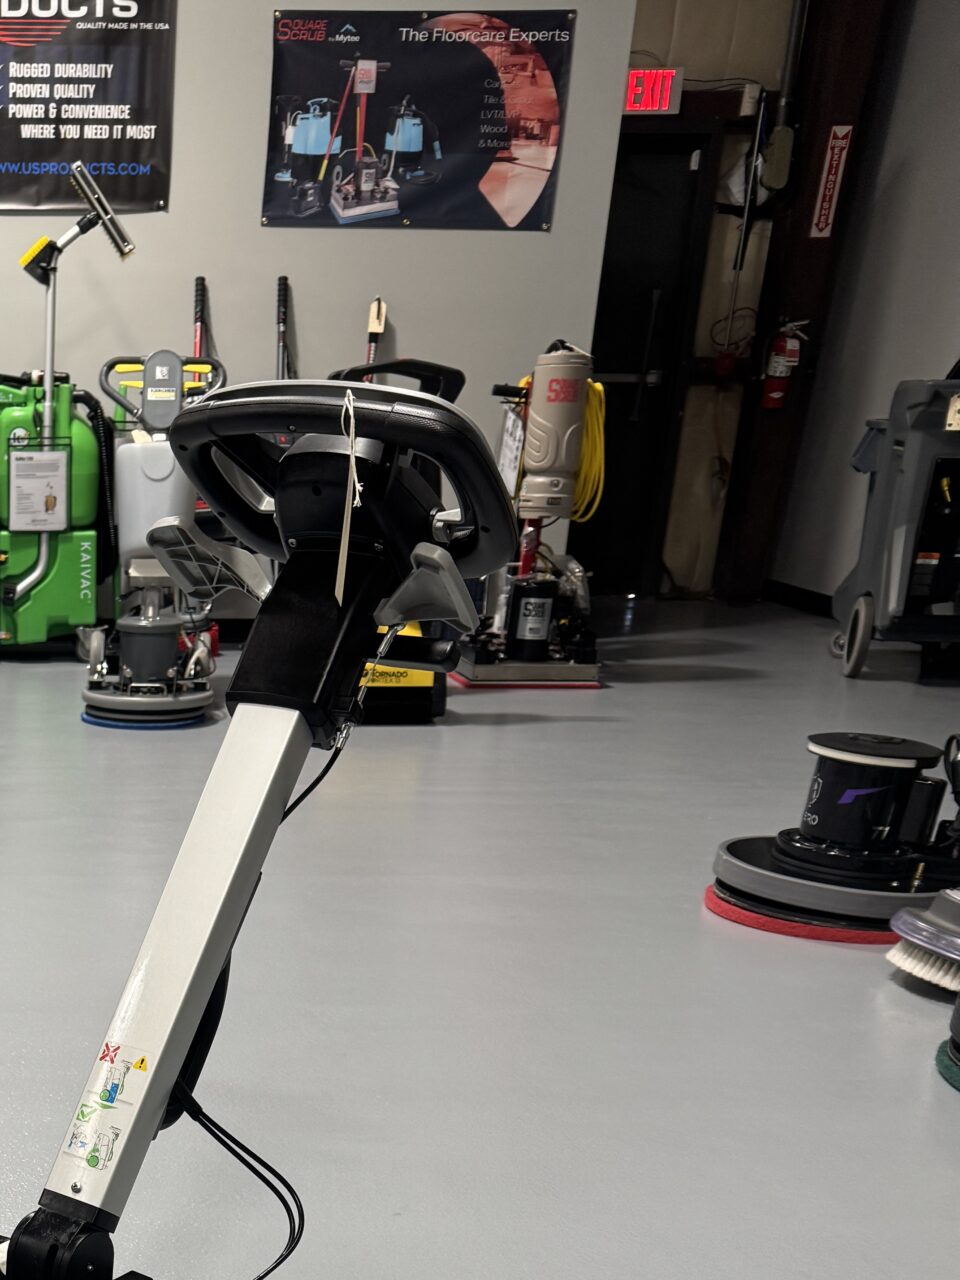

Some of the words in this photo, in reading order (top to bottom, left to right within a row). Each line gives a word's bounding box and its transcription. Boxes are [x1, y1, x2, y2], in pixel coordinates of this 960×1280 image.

[76, 22, 107, 30] QUALITY
[107, 22, 129, 30] MADE
[335, 34, 361, 43] Mytee
[399, 28, 429, 42] The
[432, 28, 506, 42] Floorcare
[509, 28, 570, 44] Experts
[9, 62, 51, 78] RUGGED
[54, 63, 114, 79] DURABILITY
[8, 82, 50, 99] PROVEN
[54, 84, 96, 100] QUALITY
[626, 69, 676, 111] EXIT
[8, 104, 46, 119] POWER
[49, 103, 57, 118] &
[61, 105, 131, 119] CONVENIENCE
[20, 124, 56, 139] WHERE
[59, 124, 81, 139] YOU
[83, 125, 109, 139] NEED
[112, 125, 124, 139] IT
[126, 125, 157, 139] MOST
[480, 124, 509, 133] Wood
[818, 147, 841, 228] EXTINGUISHER
[80, 541, 92, 600] KAIVAC
